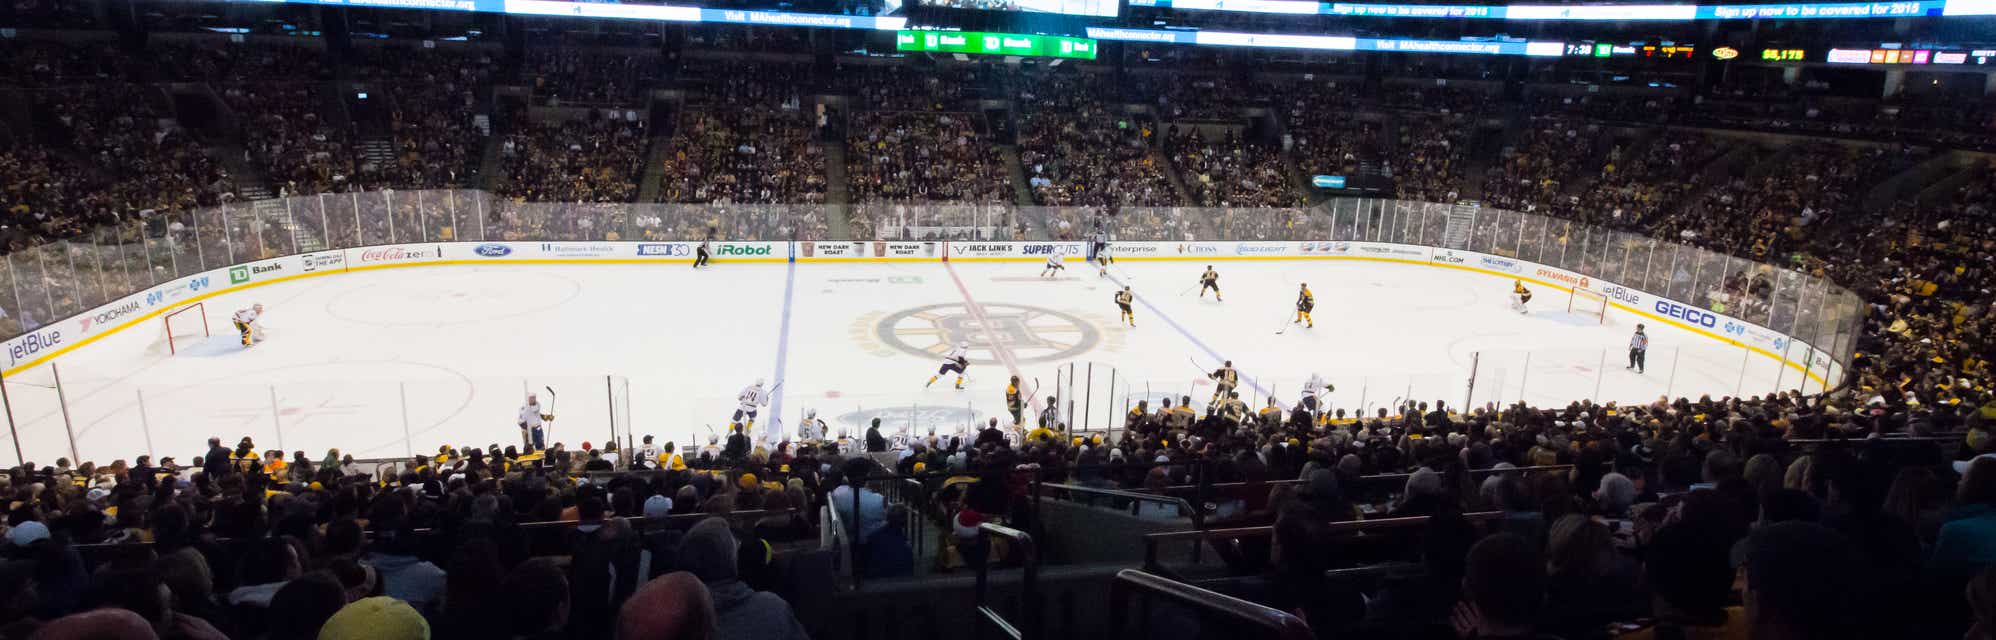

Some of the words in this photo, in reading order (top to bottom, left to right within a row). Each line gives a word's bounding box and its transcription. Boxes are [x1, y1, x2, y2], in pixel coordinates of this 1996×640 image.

[1715, 7, 1740, 18] Sign
[1742, 9, 1757, 18] up
[1759, 8, 1783, 16] now
[1786, 7, 1798, 16] to
[1801, 6, 1817, 16] be
[1819, 5, 1869, 16] covered
[1871, 4, 1888, 15] for
[1890, 3, 1919, 14] 2015
[940, 35, 966, 46] Bank
[1003, 37, 1031, 48] Bank
[362, 247, 405, 262] Coca-Cola
[717, 244, 772, 255] iRobot
[252, 263, 281, 274] Bank
[1536, 268, 1577, 284] SYLVANIA
[94, 301, 140, 325] YOKOHAMA
[1655, 300, 1717, 329] GEICO
[8, 328, 62, 366] jetBlue
